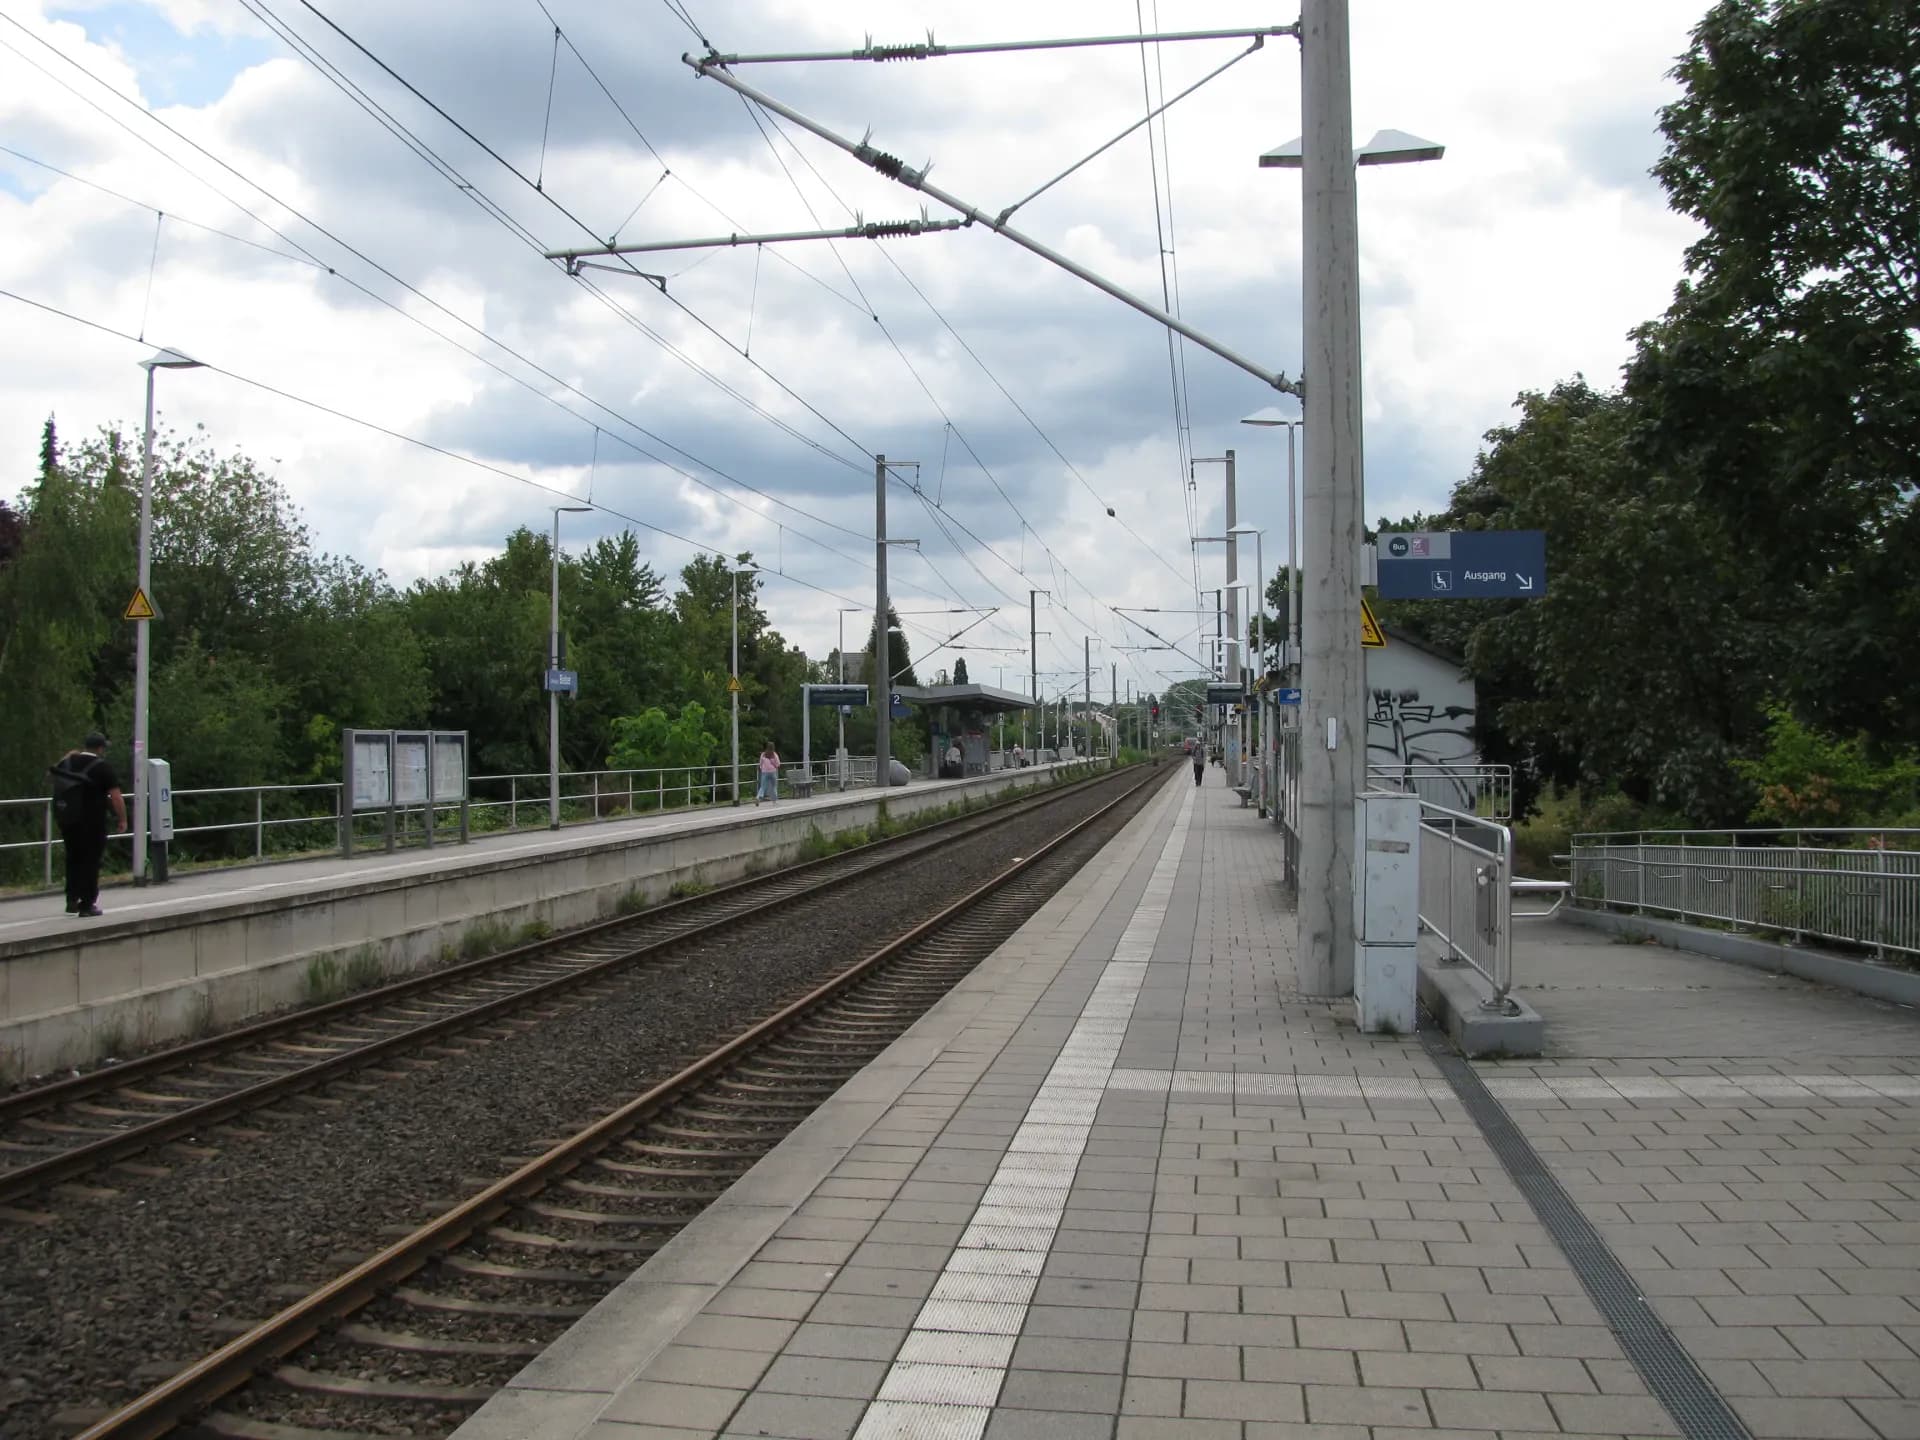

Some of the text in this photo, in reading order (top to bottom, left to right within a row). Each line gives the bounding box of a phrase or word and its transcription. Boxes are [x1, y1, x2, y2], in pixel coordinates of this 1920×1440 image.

[1392, 543, 1406, 551] Bus
[1463, 570, 1506, 582] Ausgang
[893, 694, 900, 705] 2
